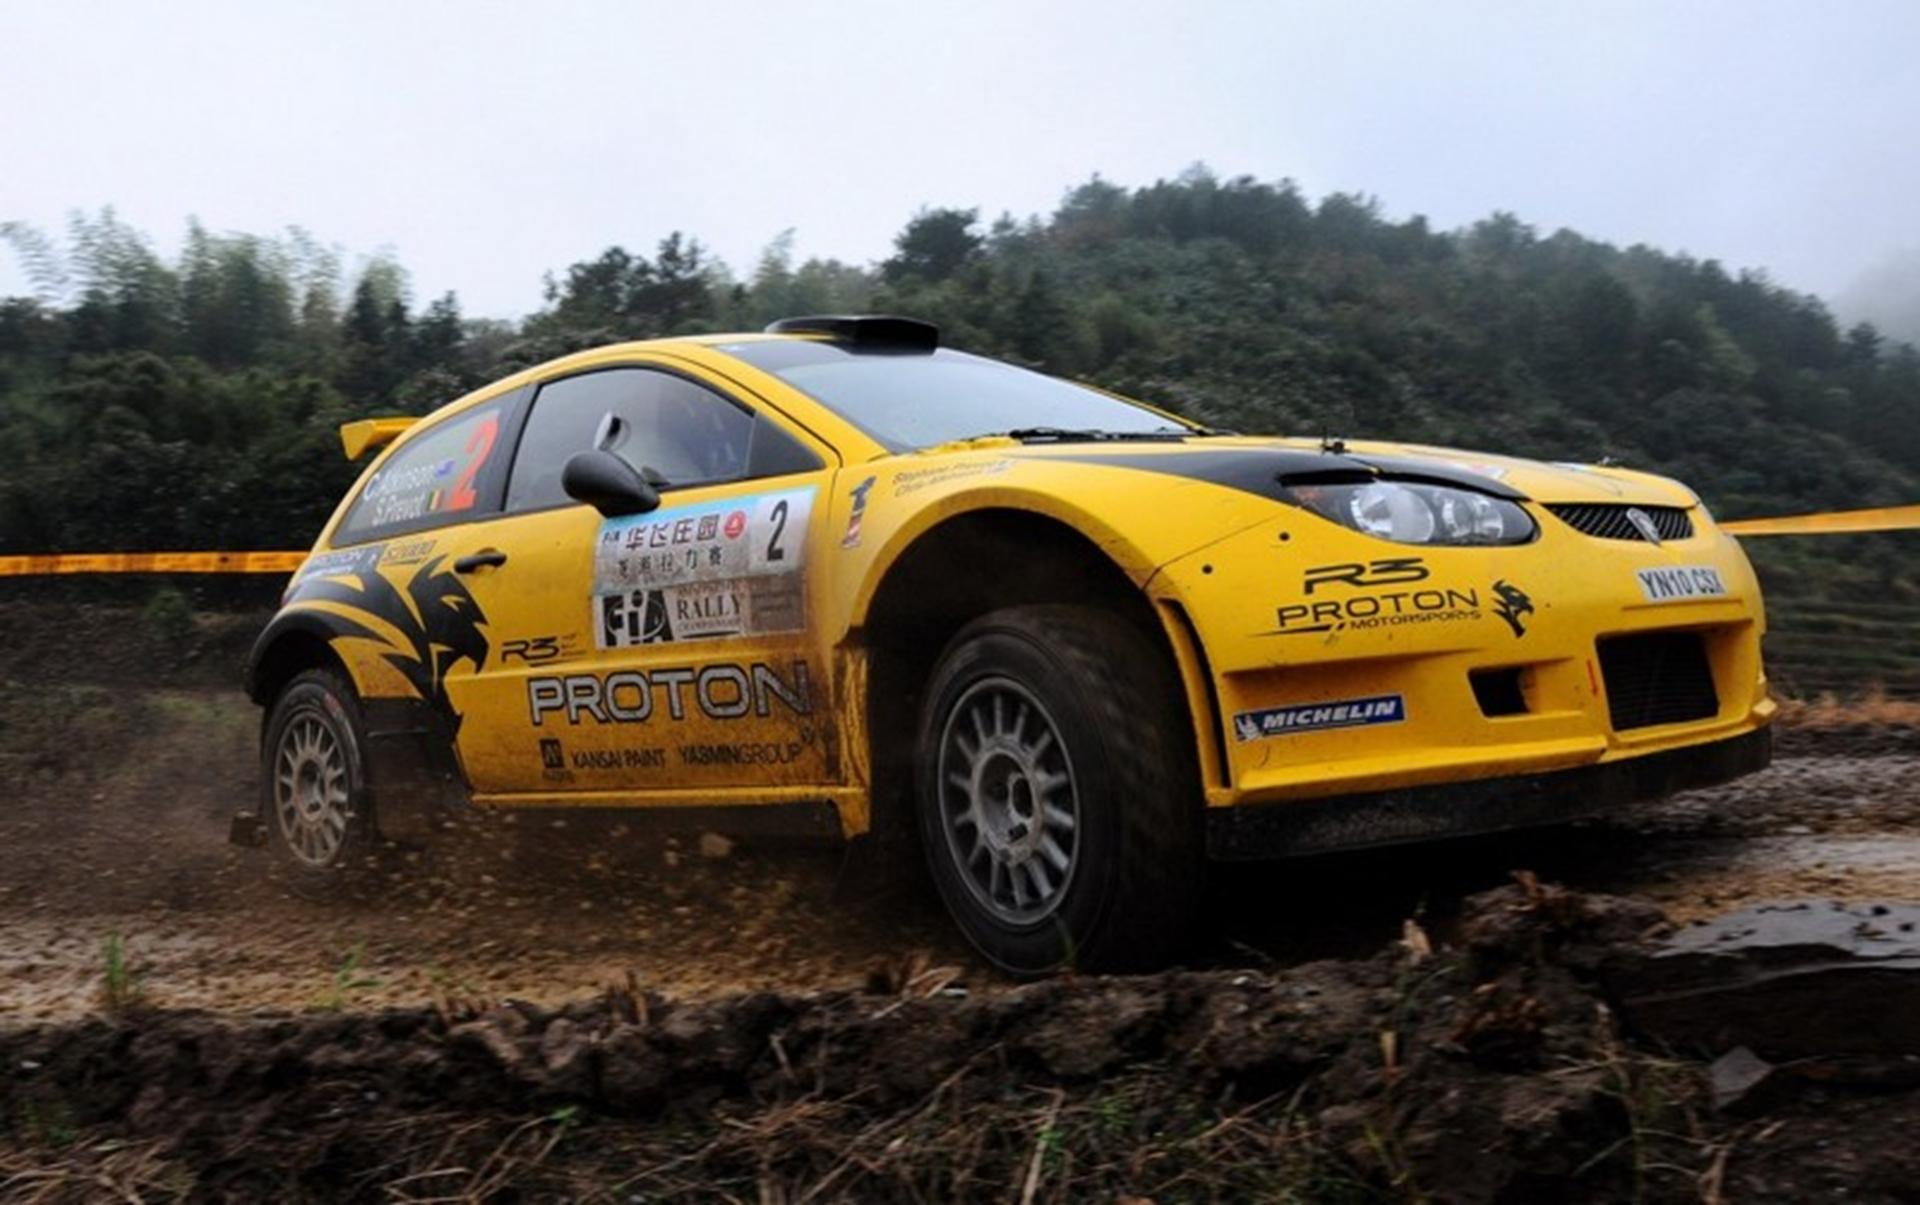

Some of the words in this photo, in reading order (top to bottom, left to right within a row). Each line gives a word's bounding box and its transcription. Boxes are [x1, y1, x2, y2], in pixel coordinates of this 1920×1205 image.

[449, 417, 500, 511] 2
[766, 499, 789, 561] 2
[1304, 557, 1430, 595] R3
[676, 593, 741, 621] RALLY
[1276, 588, 1479, 628] PROTON
[1350, 609, 1482, 631] MOTORSPORTS
[527, 661, 812, 726] PROTON
[1262, 700, 1397, 729] MICHELIN
[623, 747, 666, 769] PAINT
